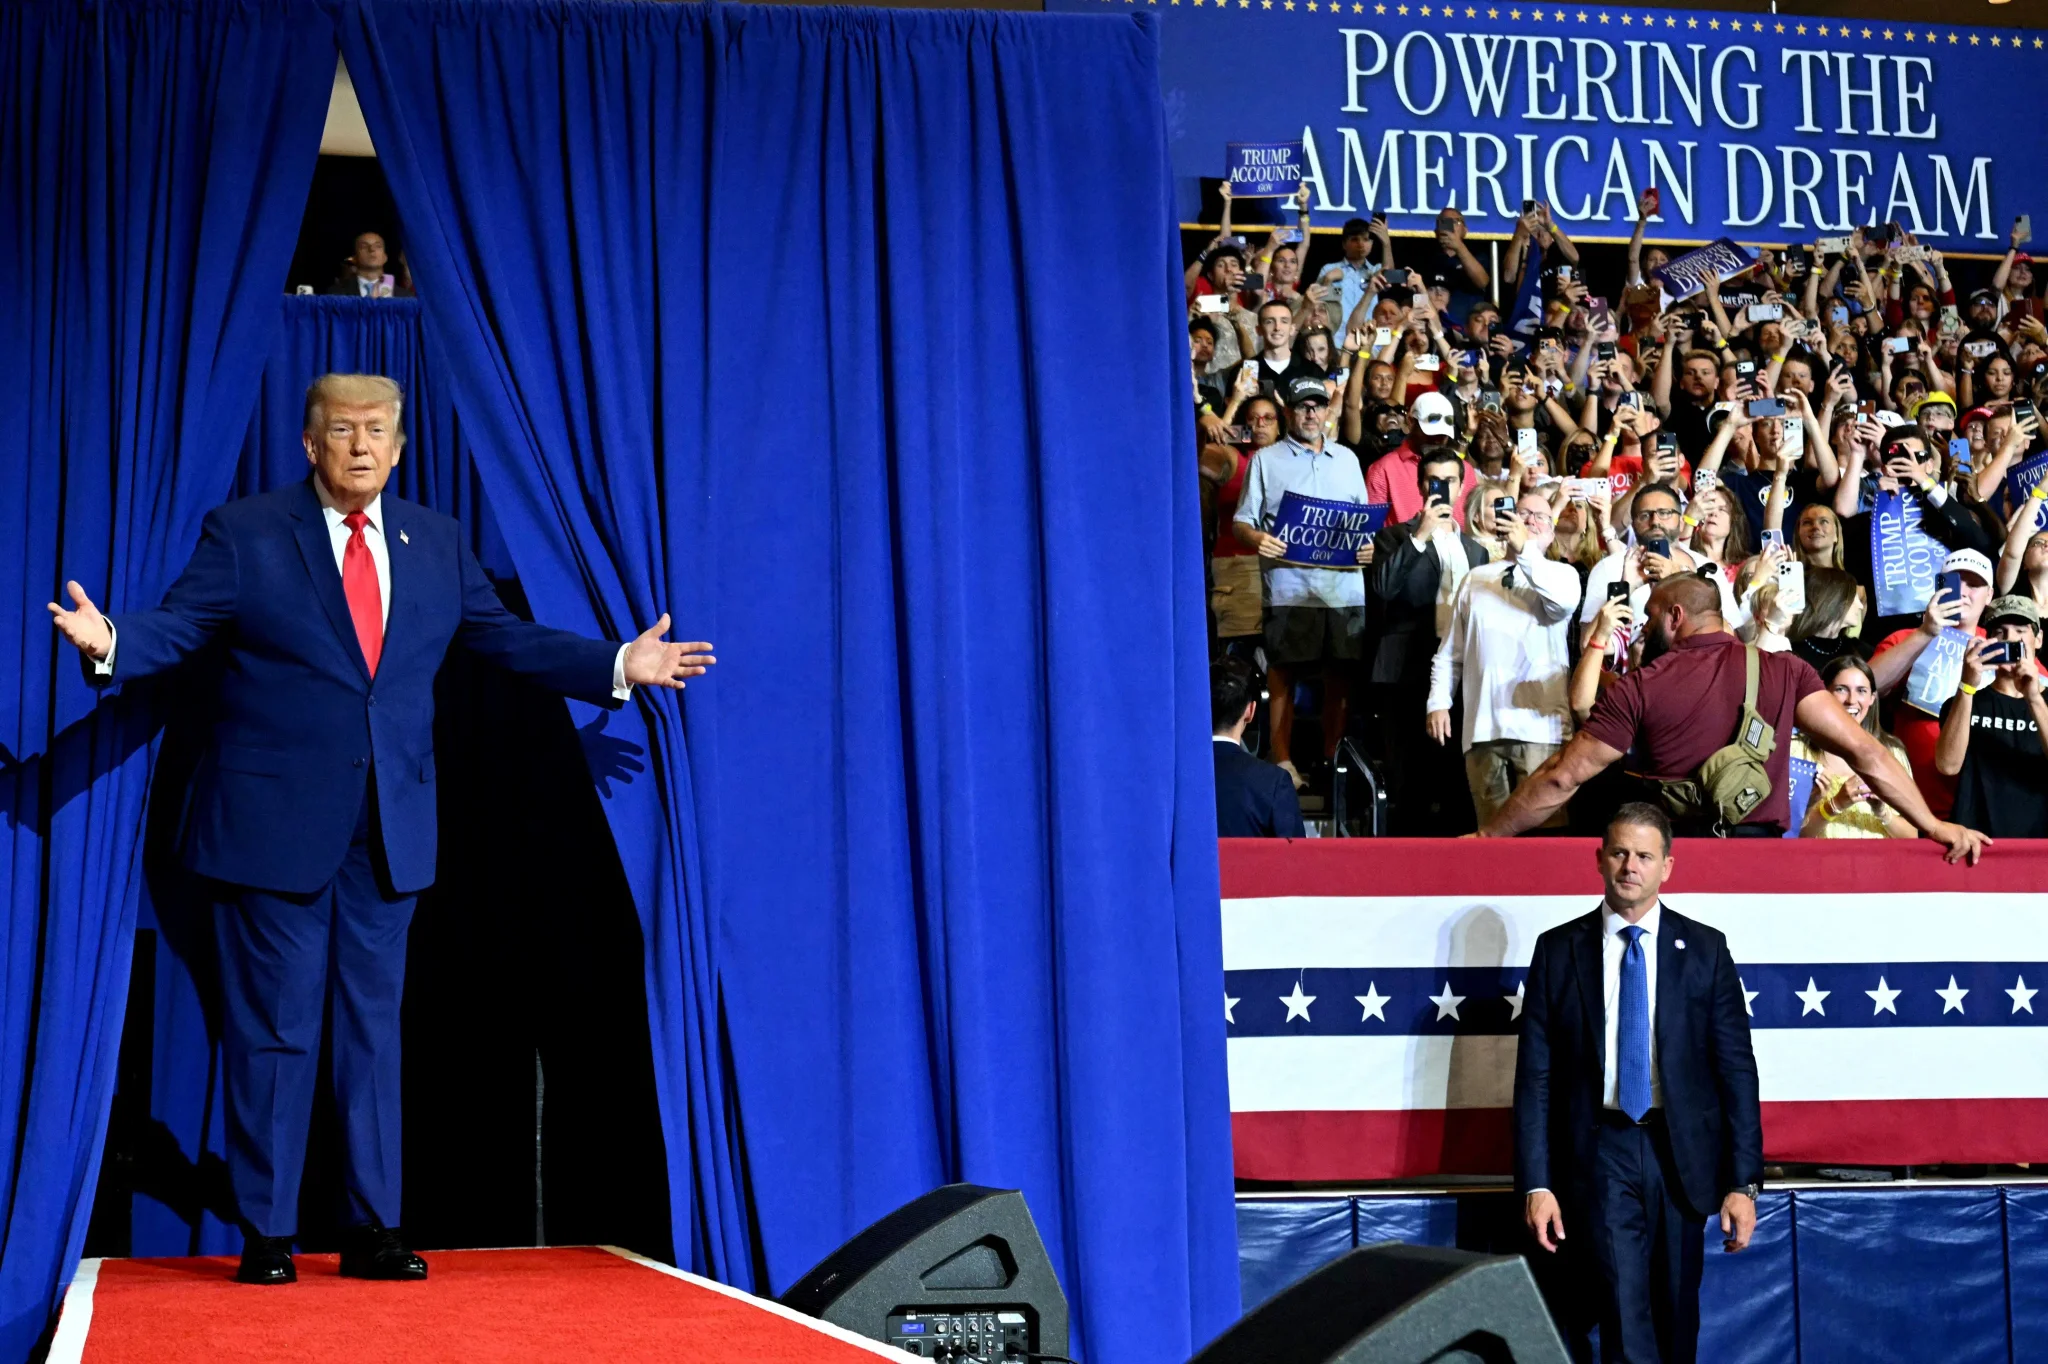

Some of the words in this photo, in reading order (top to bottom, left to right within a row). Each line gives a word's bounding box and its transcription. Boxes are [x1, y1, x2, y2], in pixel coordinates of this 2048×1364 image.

[1338, 28, 1763, 130] POWERING
[1781, 48, 1937, 139] THE
[1241, 148, 1291, 165] TRUMP
[1229, 164, 1301, 183] ACCOUNTS
[1281, 125, 1698, 225] AMERICAN
[1719, 142, 1999, 240] DREAM
[1301, 504, 1370, 531] TRUMP
[1309, 549, 1334, 561] .GOV
[1880, 512, 1908, 591] TRUMP
[1970, 715, 2038, 732] FREEDO
